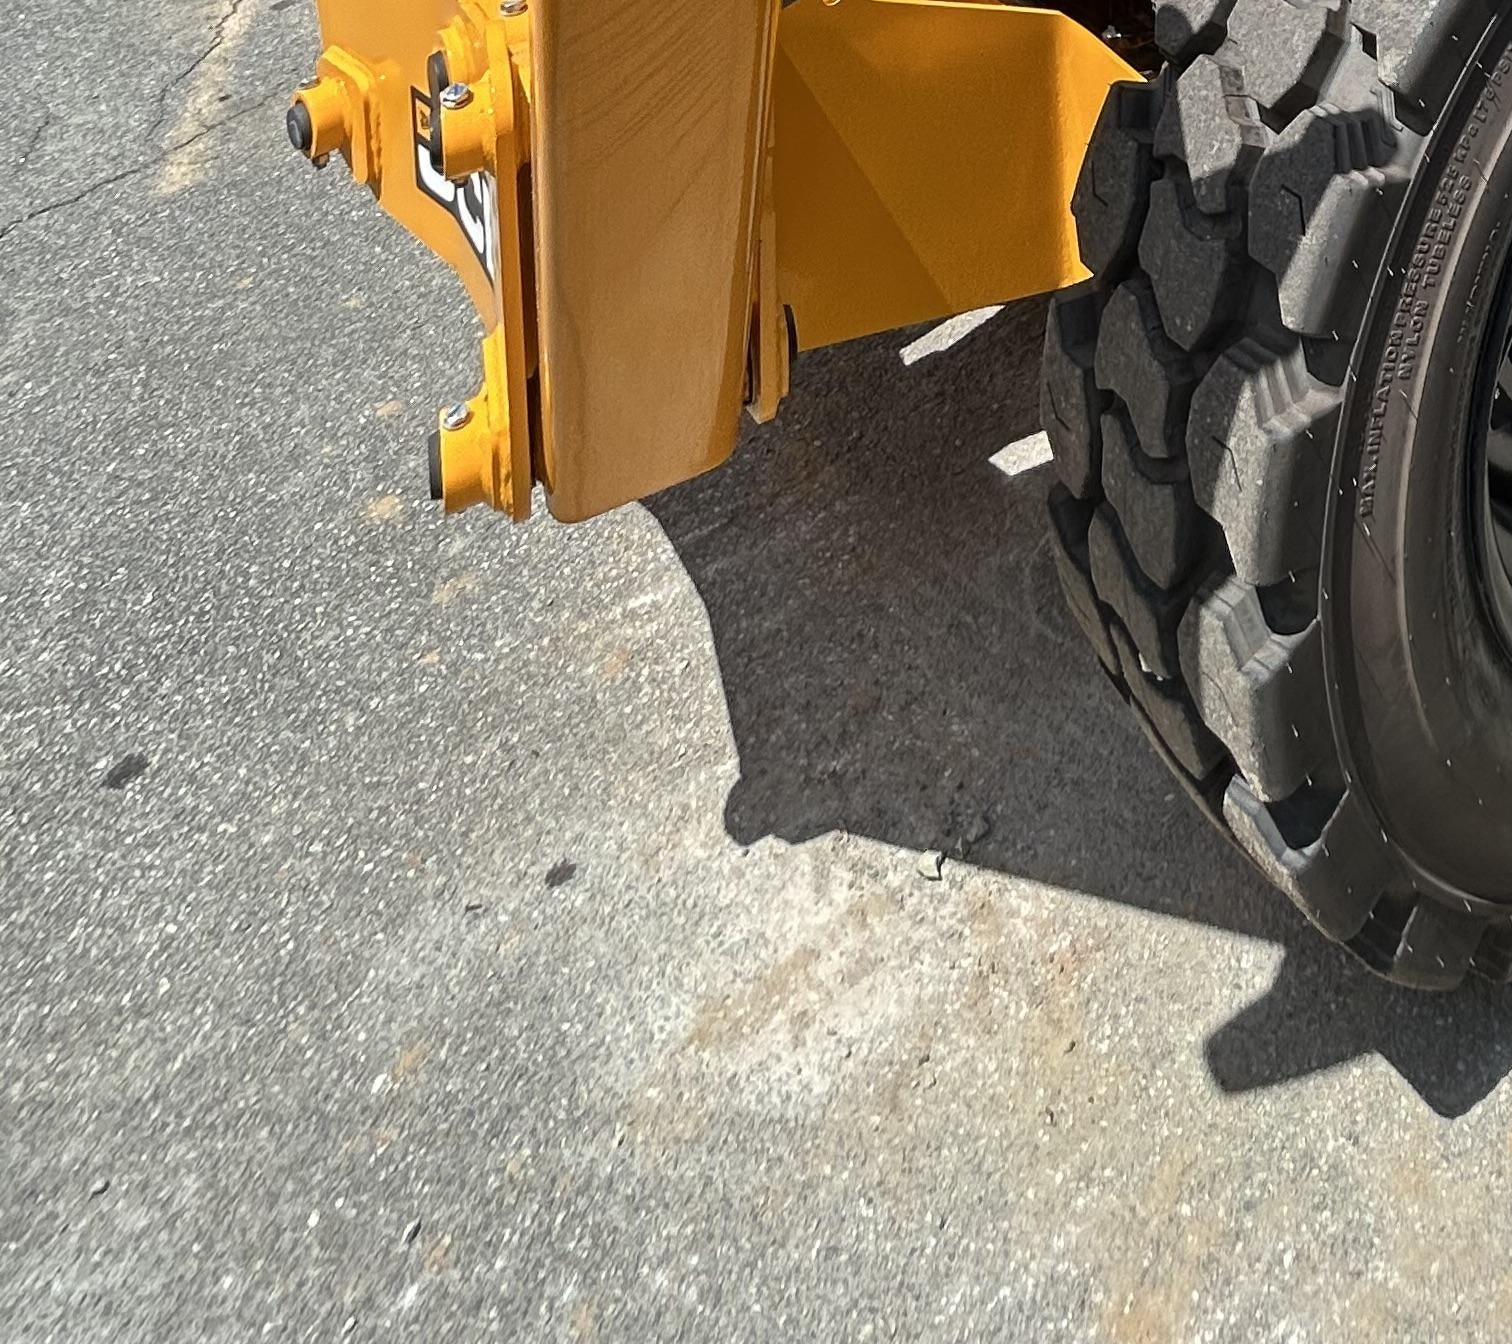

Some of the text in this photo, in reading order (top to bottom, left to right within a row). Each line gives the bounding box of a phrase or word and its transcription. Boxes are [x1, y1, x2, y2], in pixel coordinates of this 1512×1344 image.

[1366, 328, 1404, 454] INFLATION
[1393, 208, 1443, 329] PRESSURE
[1397, 173, 1473, 381] NYLON TUBELESS
